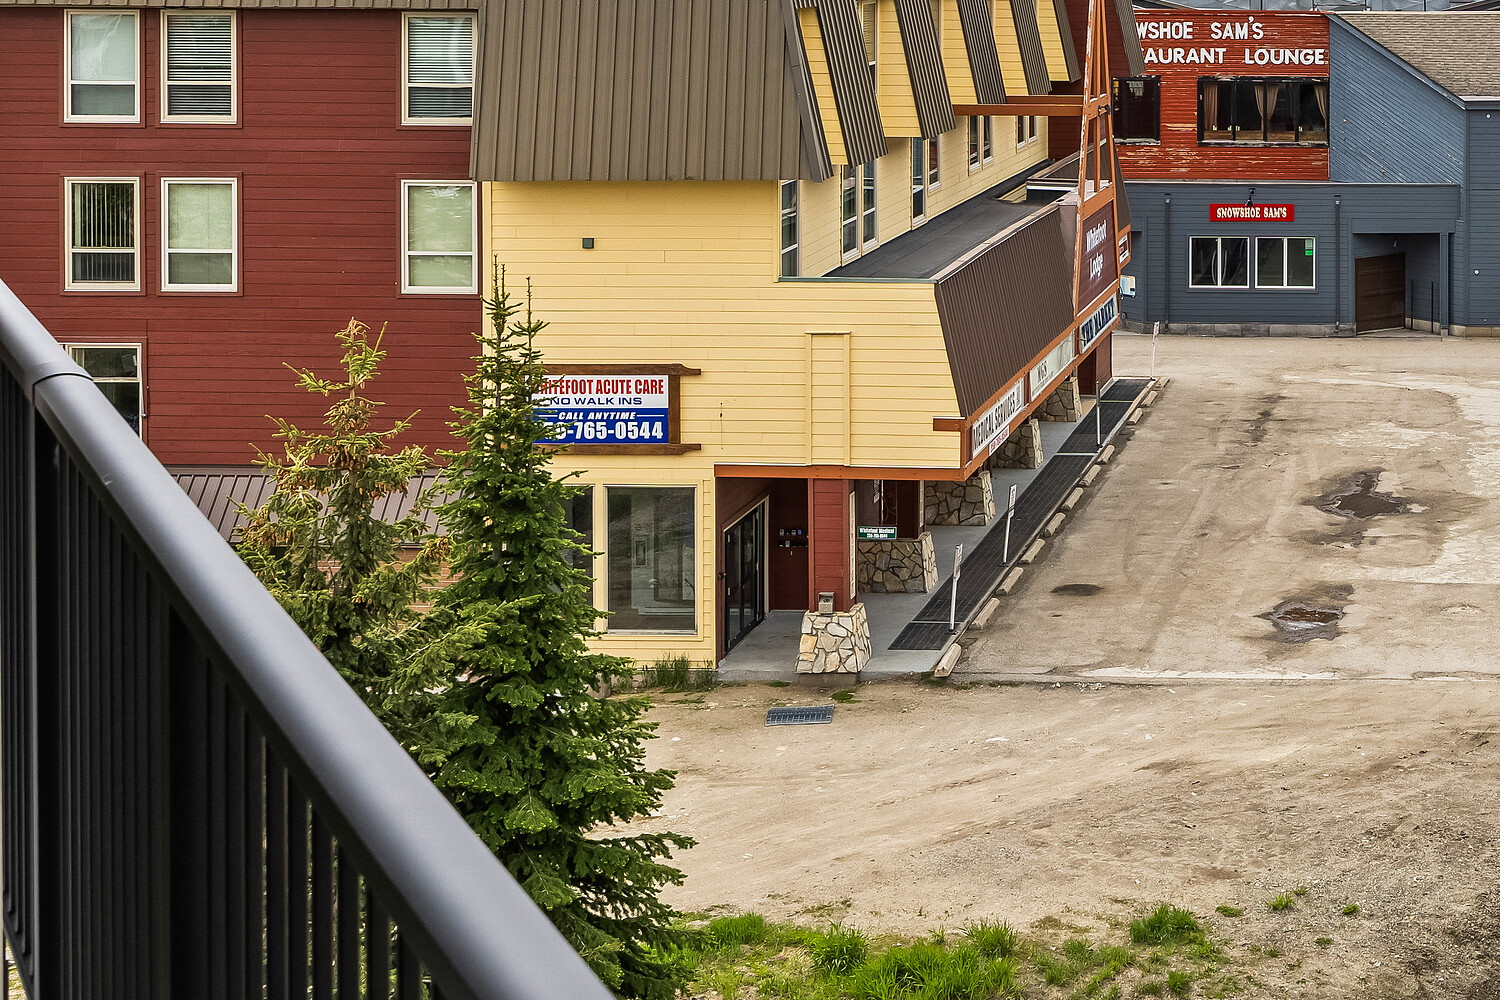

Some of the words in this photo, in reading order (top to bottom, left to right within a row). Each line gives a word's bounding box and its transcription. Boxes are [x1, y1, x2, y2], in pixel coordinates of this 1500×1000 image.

[1210, 16, 1264, 40] SAM'S
[1141, 47, 1226, 64] AURANT
[1244, 48, 1325, 65] LOUNGE
[1216, 206, 1261, 218] SNOWSHOE
[1263, 207, 1287, 218] SAM'S
[1086, 219, 1107, 253] Whitefoot
[1089, 252, 1104, 279] Lodge
[1093, 297, 1114, 336] MARKET
[595, 379, 632, 394] ACUTE
[634, 379, 664, 394] CARE
[549, 397, 571, 405] NO
[573, 397, 614, 405] WALK
[618, 397, 643, 405] INS
[558, 411, 585, 420] CALL
[587, 411, 637, 420] ANYTIME
